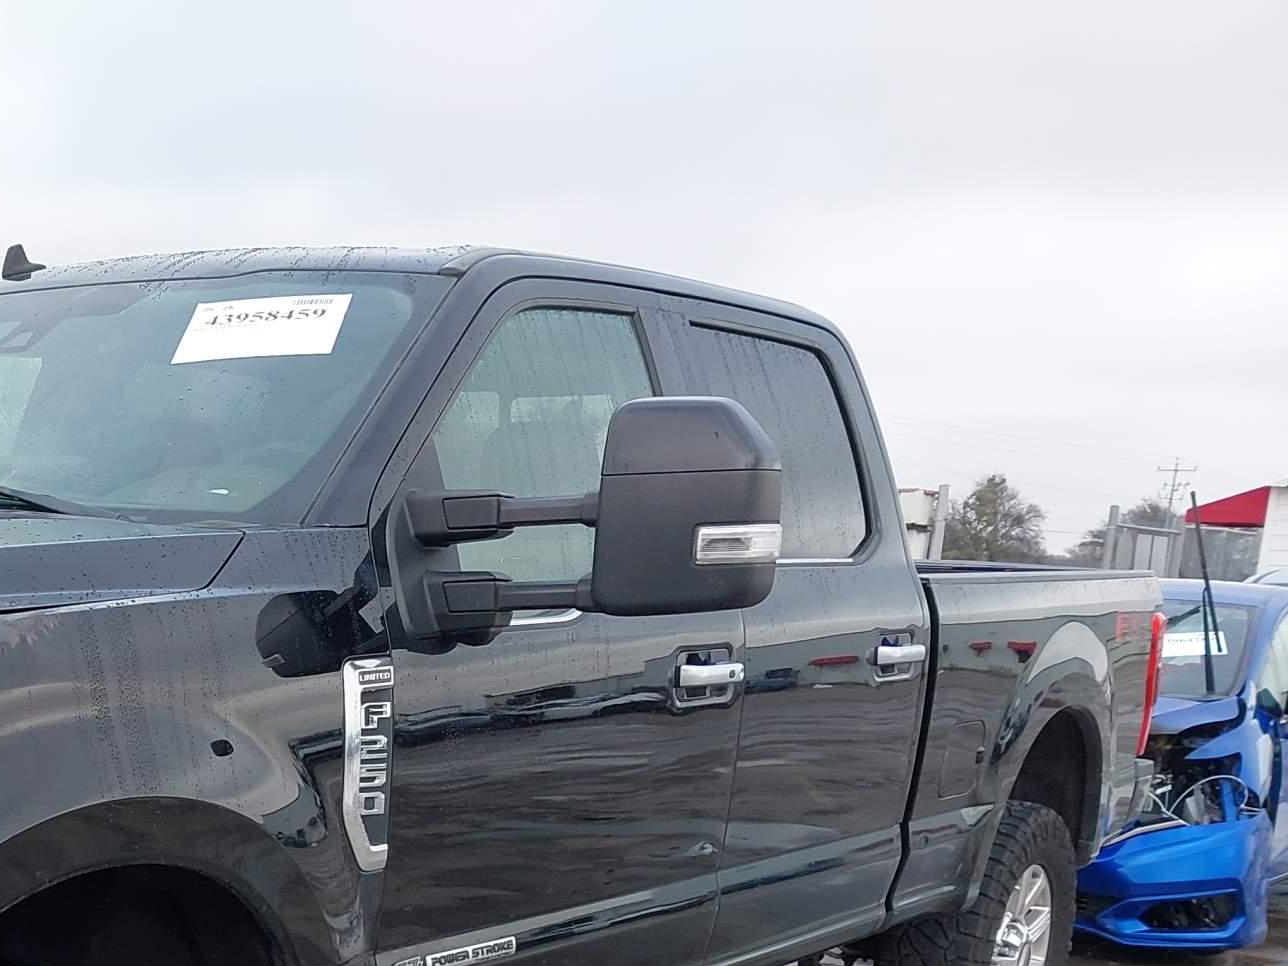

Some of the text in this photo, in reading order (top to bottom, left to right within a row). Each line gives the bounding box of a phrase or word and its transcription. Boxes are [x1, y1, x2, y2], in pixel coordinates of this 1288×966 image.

[204, 308, 327, 326] 43958459
[359, 670, 392, 682] LIMITED
[471, 939, 514, 959] STROKE
